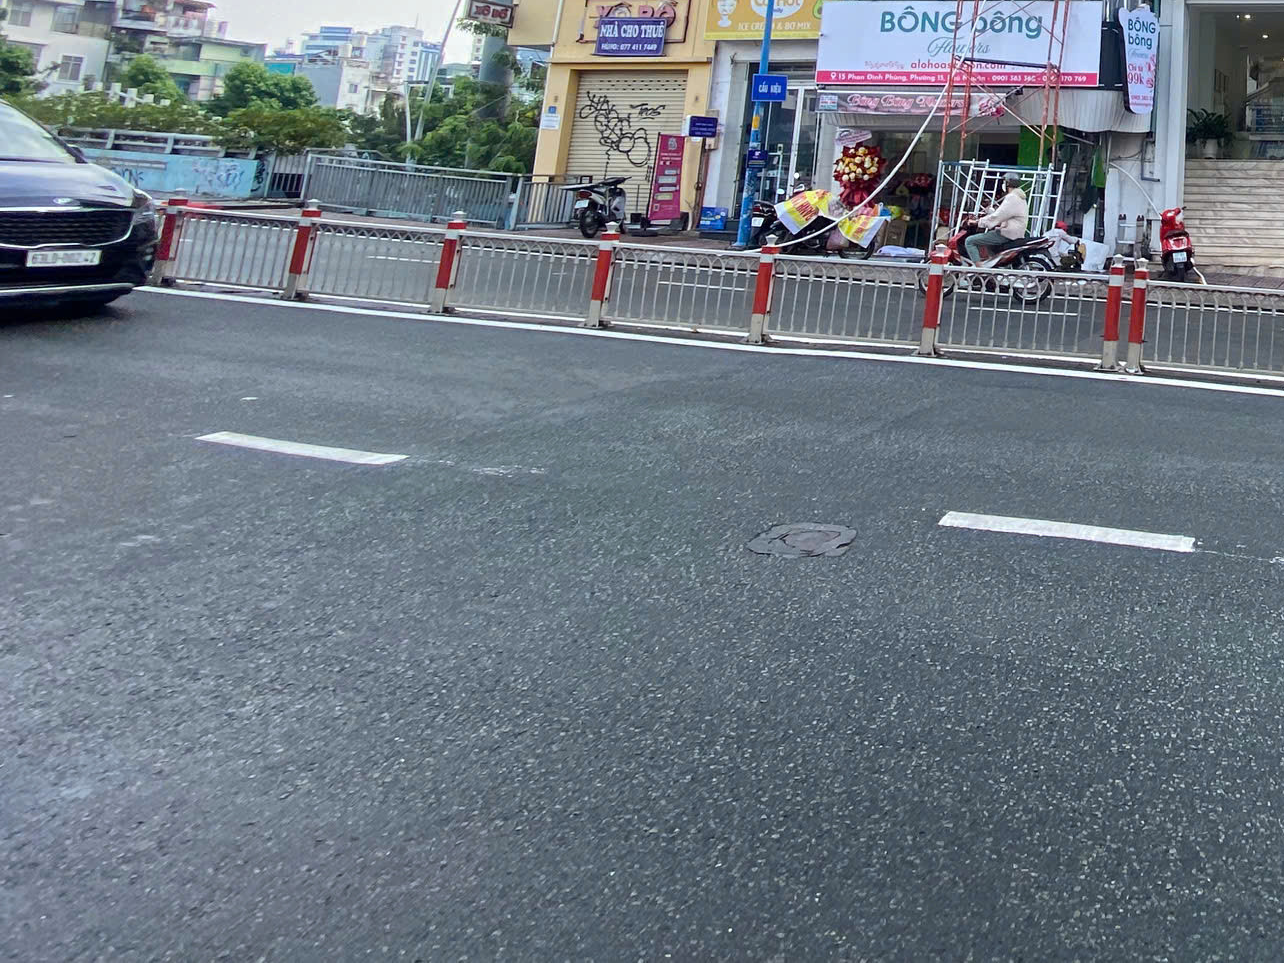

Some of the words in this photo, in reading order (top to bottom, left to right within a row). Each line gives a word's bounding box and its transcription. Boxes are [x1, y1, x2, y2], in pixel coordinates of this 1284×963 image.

[600, 21, 618, 37] NHÀ
[621, 25, 639, 38] CHO
[641, 22, 665, 37] THUÊ
[880, 6, 961, 33] BÔNG
[970, 11, 1043, 39] bông
[1128, 17, 1156, 34] BÔNG
[1128, 33, 1152, 50] bông
